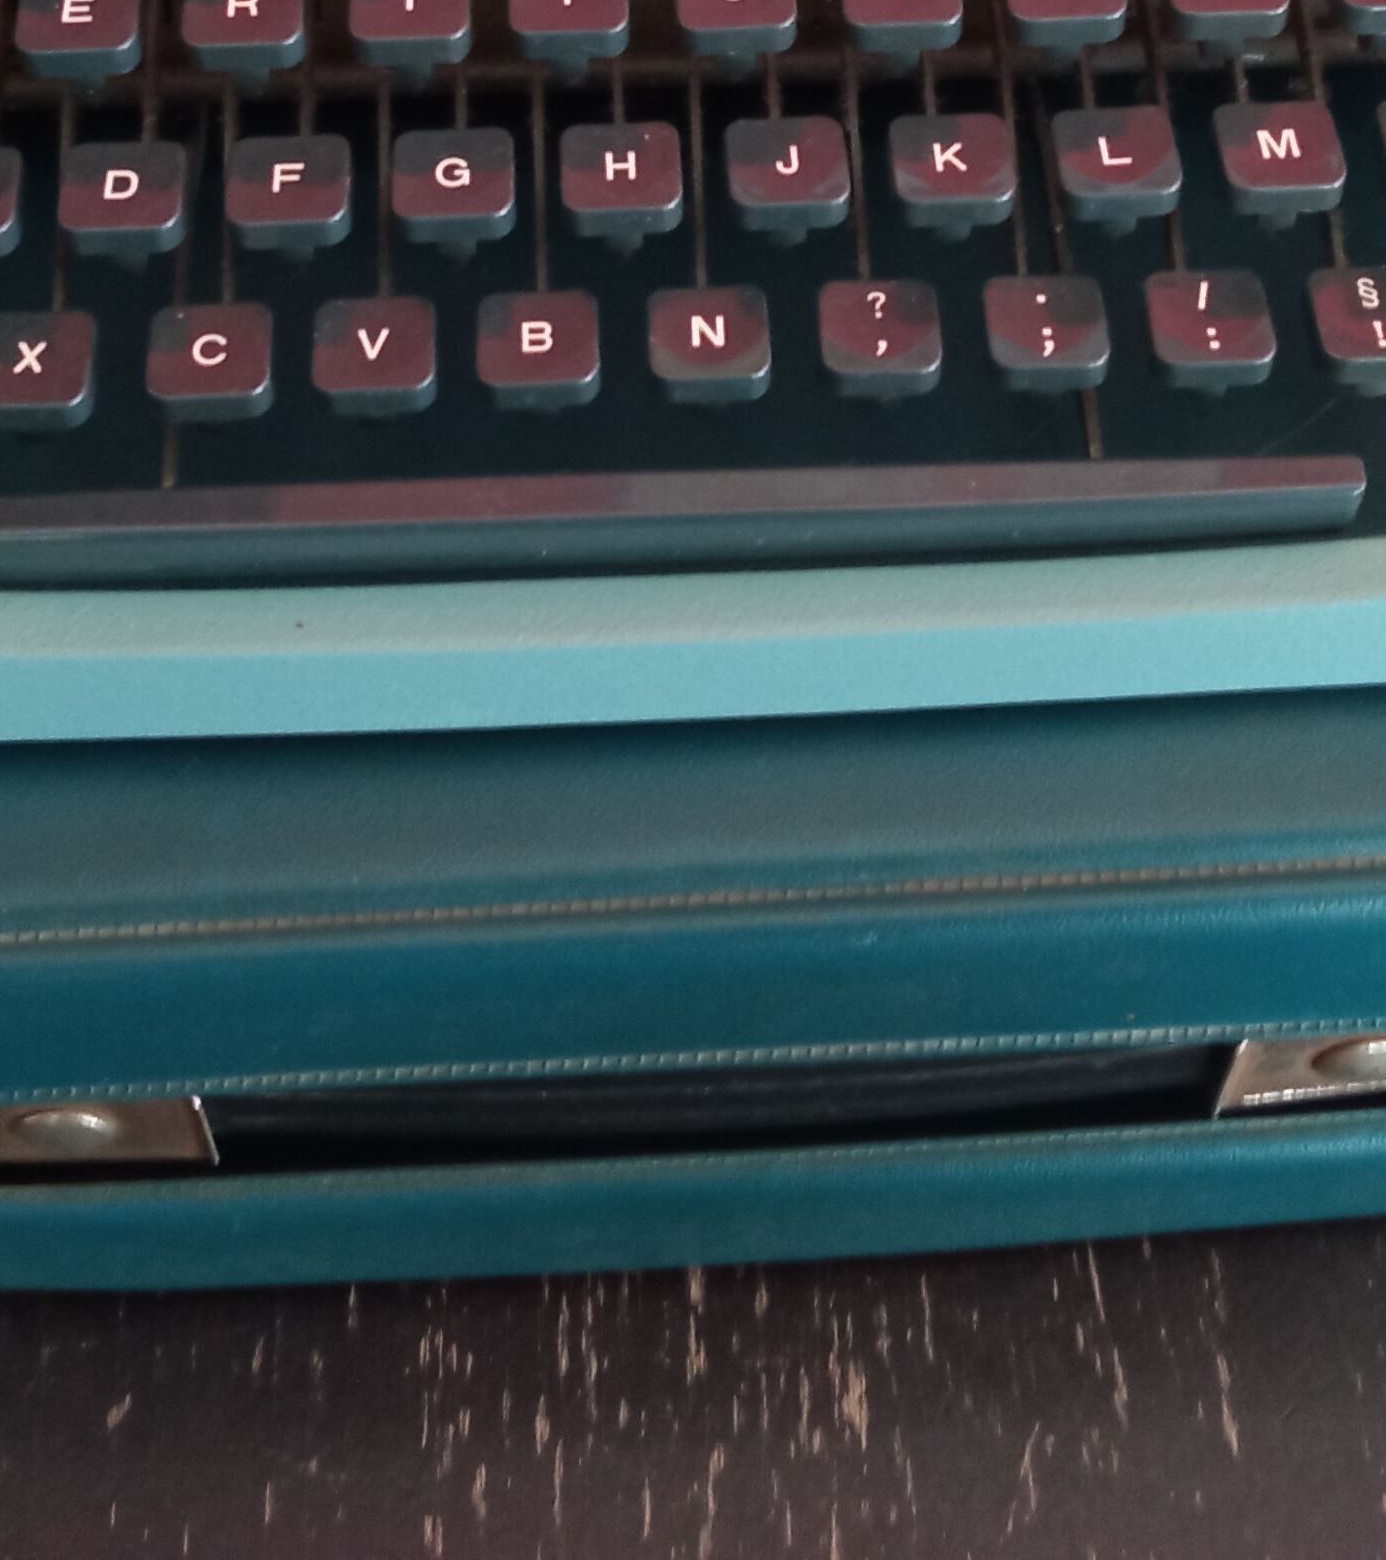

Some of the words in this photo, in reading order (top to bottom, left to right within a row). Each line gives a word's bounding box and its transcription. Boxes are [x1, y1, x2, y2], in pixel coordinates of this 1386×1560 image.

[104, 170, 138, 199] D
[273, 163, 304, 192] F
[436, 158, 470, 187] G
[605, 151, 635, 180] H
[776, 146, 798, 174] J
[933, 143, 966, 171] K
[1099, 137, 1132, 165] L
[1257, 129, 1300, 159] M
[14, 342, 46, 373] X
[193, 334, 226, 365] C
[358, 329, 389, 359] V
[522, 322, 552, 352] B
[692, 316, 724, 346] N
